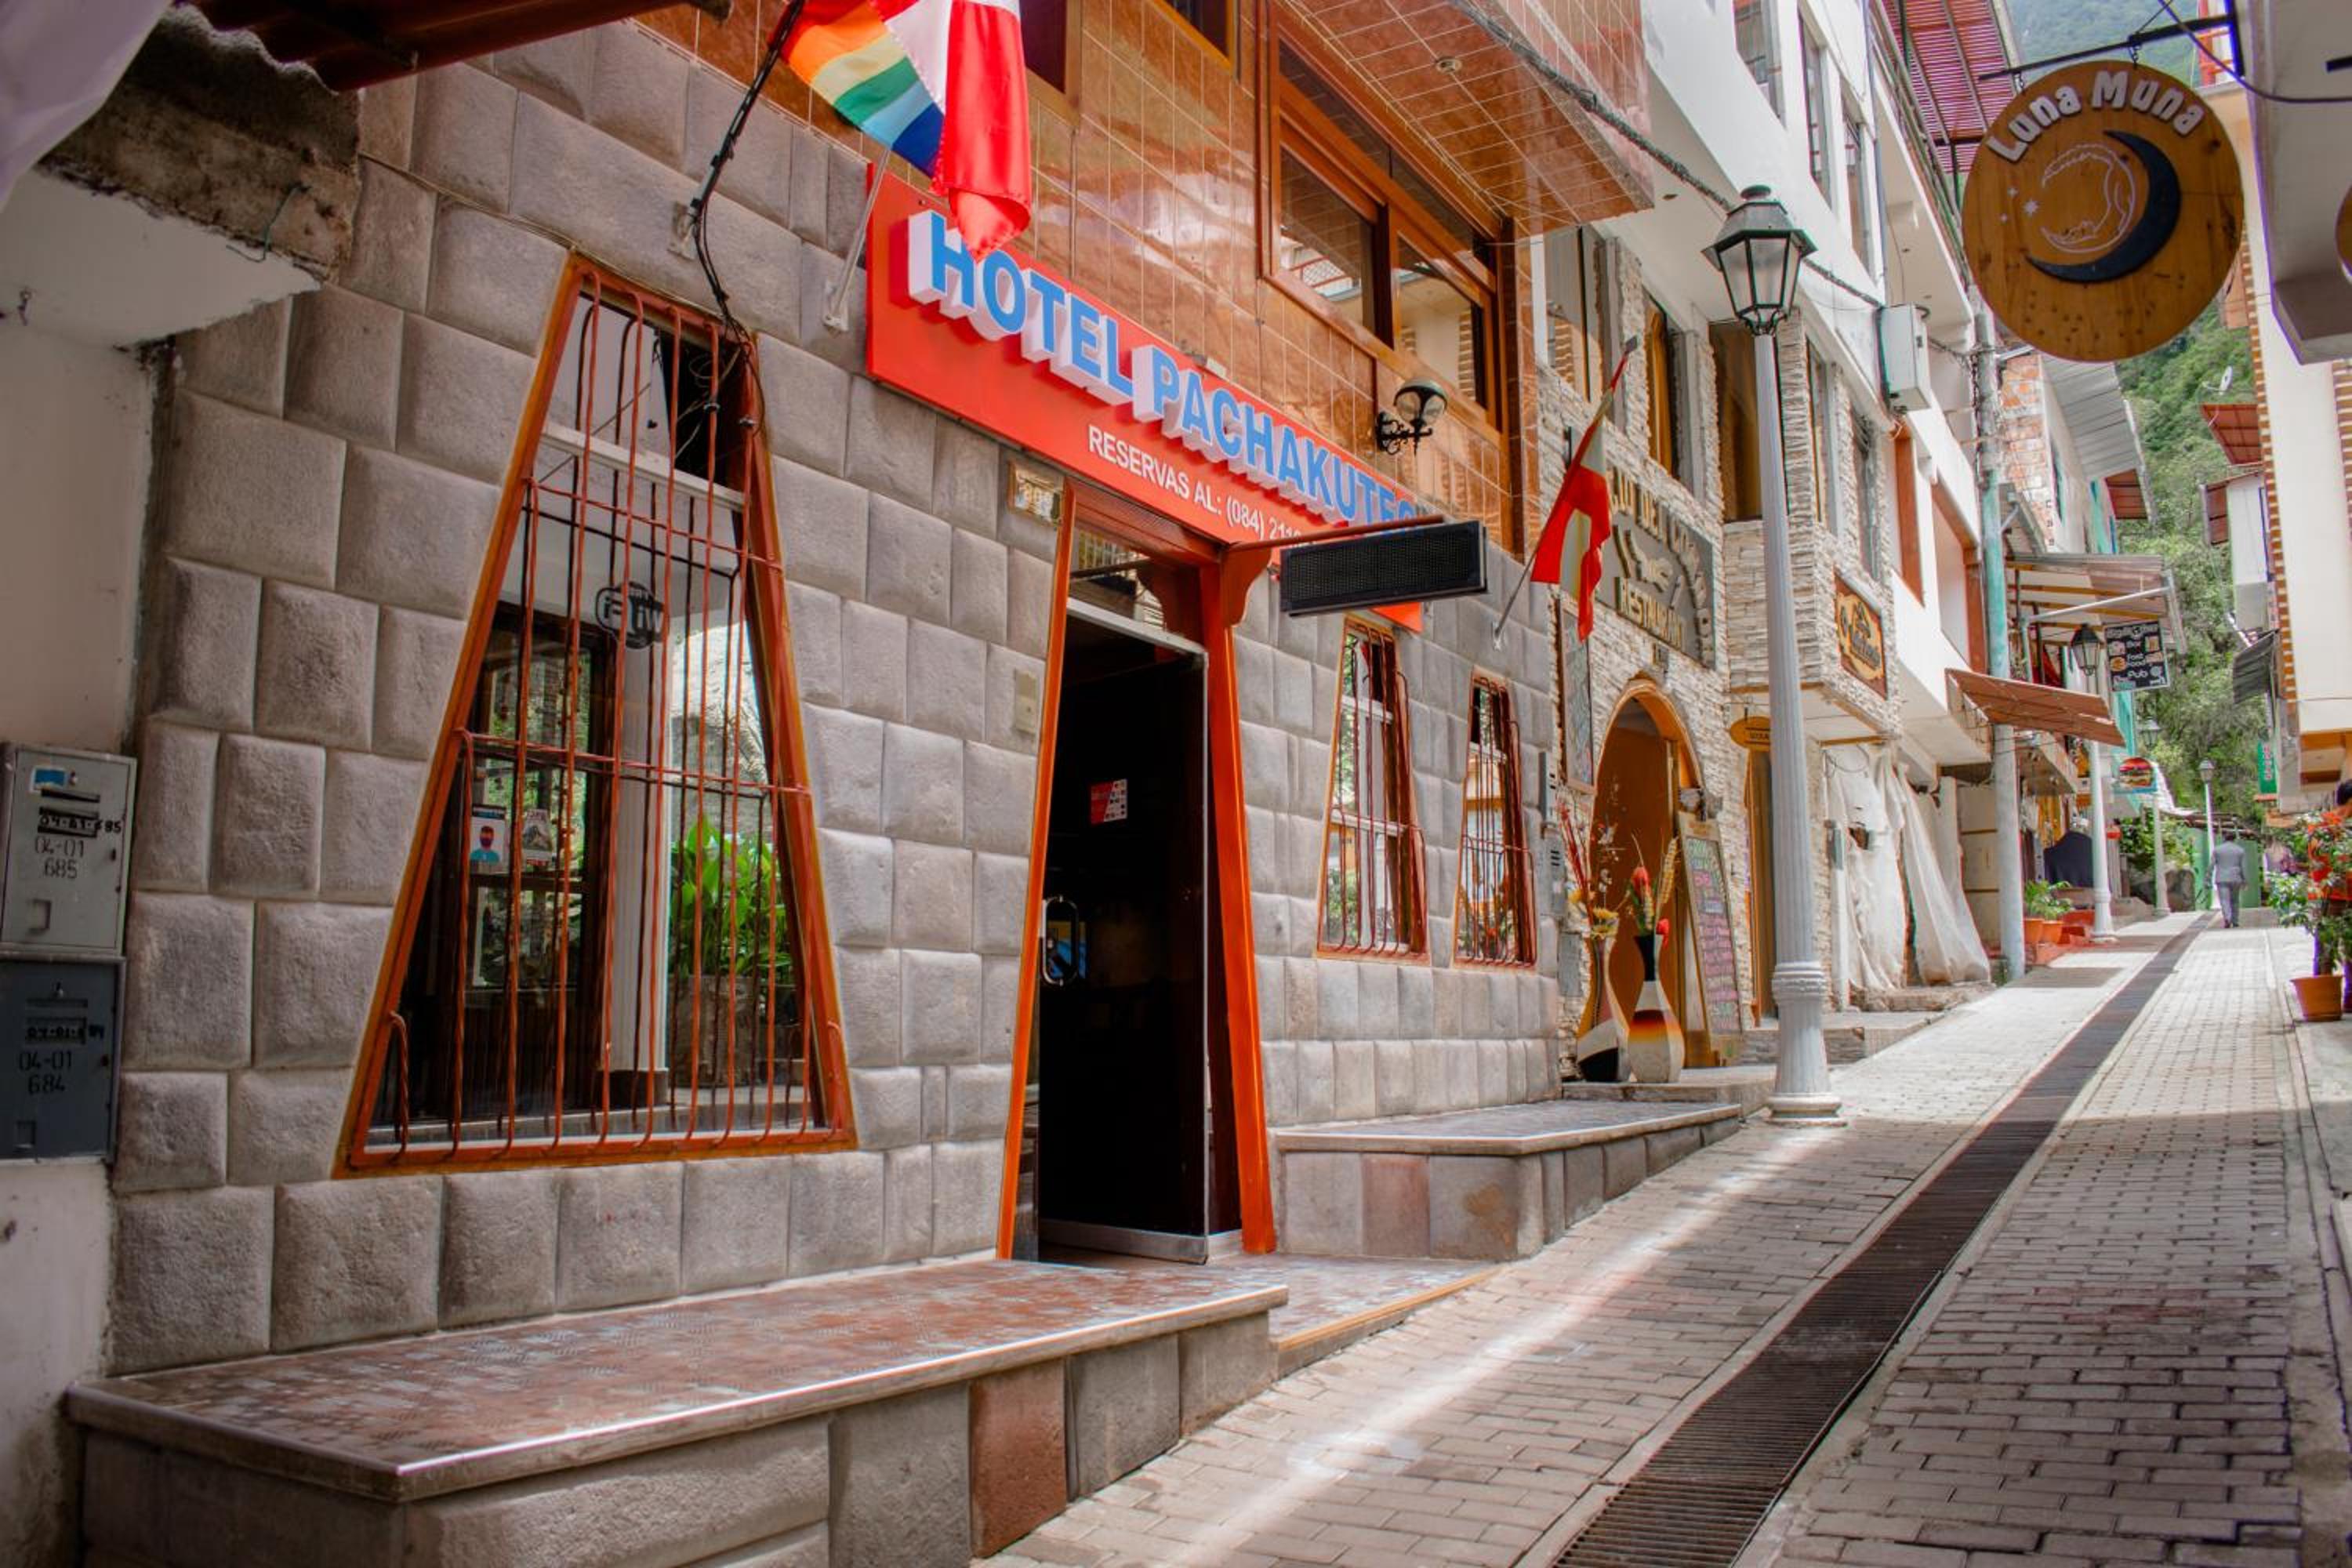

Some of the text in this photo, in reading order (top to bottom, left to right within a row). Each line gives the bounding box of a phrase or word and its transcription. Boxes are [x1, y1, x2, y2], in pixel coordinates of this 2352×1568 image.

[1985, 70, 2206, 163] Luna Muna
[909, 210, 1134, 405] HOTEL
[1088, 423, 1190, 499] RESERVAS
[1193, 480, 1221, 514] AL:
[1226, 495, 1265, 541] (084)
[44, 857, 78, 879] 685
[18, 1050, 72, 1072] 04-01
[27, 1073, 66, 1095] 684
